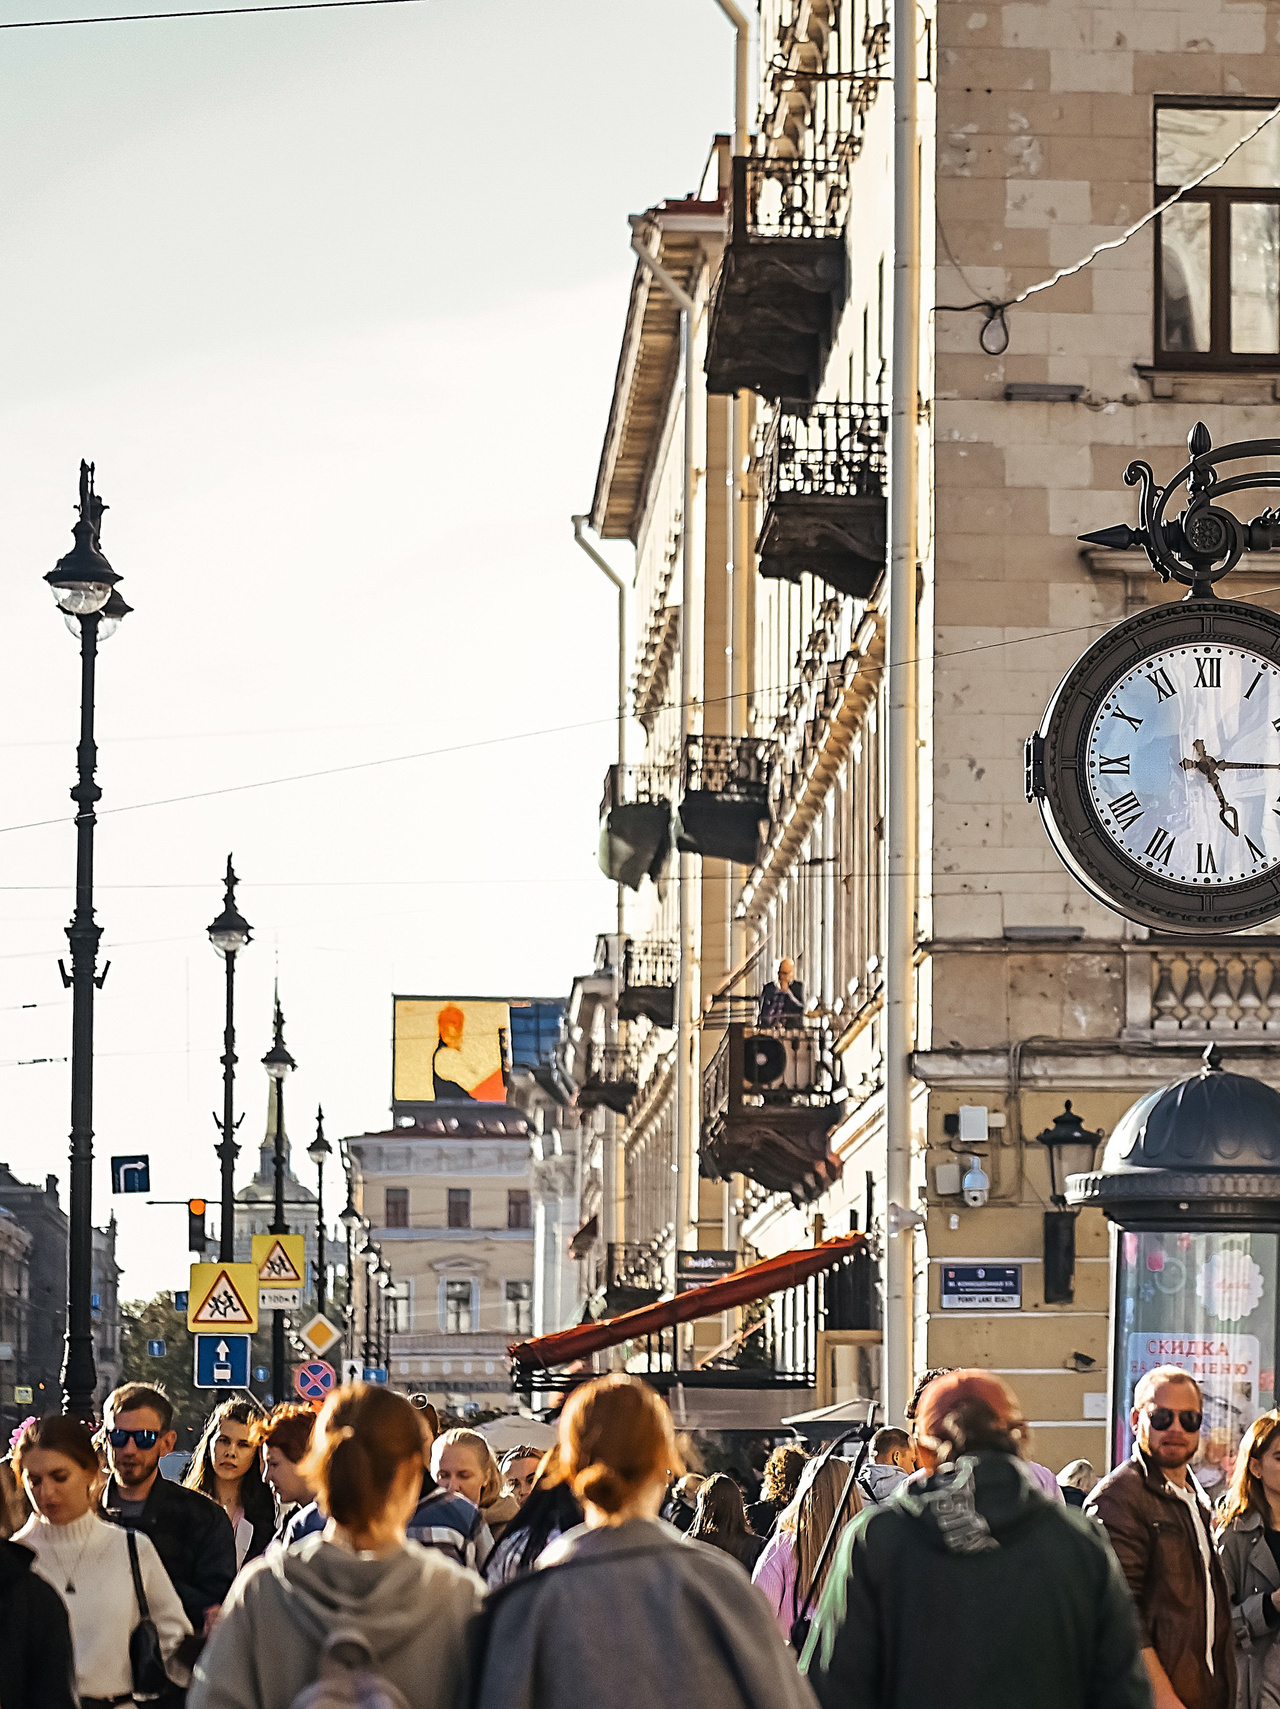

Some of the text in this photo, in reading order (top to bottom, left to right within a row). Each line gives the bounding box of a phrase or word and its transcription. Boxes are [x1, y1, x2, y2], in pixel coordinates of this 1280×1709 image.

[1145, 667, 1177, 703] XI
[1194, 657, 1222, 688] XII
[1111, 704, 1144, 733] X
[1099, 754, 1130, 775] IX
[1107, 790, 1145, 832] VIII
[1144, 827, 1176, 867] VII
[1196, 843, 1218, 874] VI
[1244, 834, 1266, 863] V
[1147, 1339, 1230, 1358] СКИДКА
